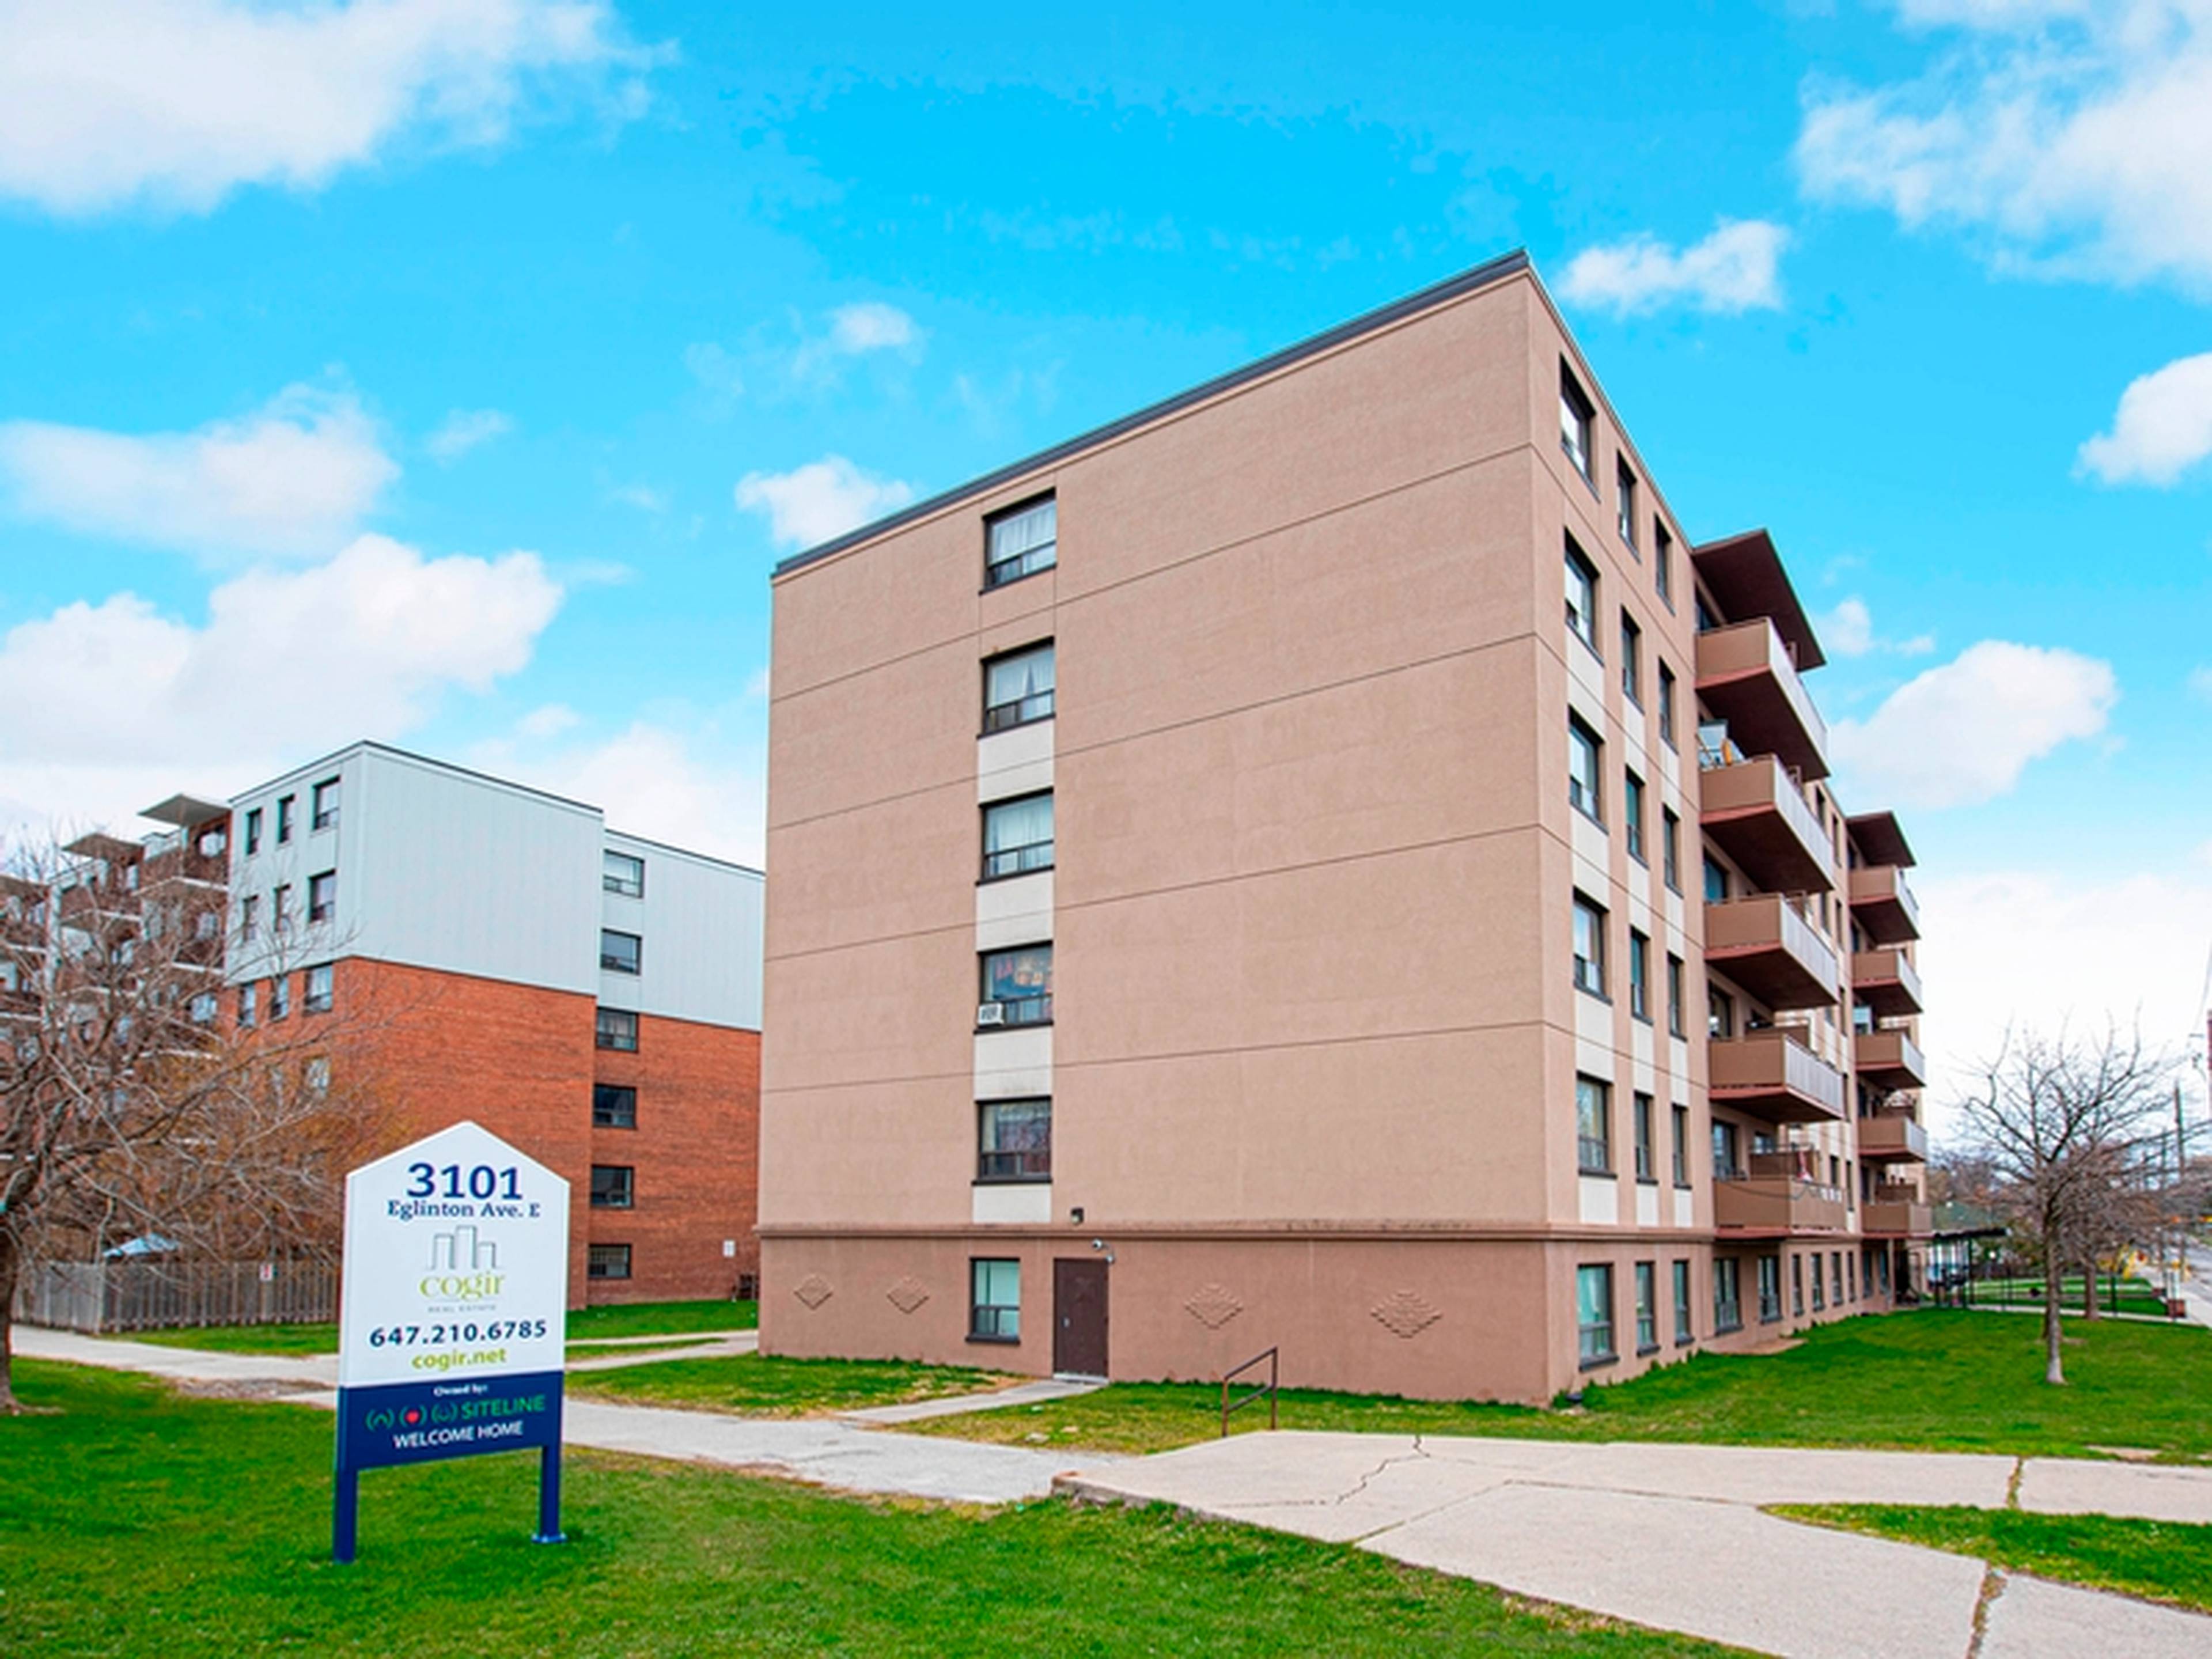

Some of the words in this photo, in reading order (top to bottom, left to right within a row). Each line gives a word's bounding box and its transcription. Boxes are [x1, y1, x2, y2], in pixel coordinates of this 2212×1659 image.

[407, 1162, 522, 1200] 3101
[388, 1200, 474, 1221] Eglinton
[481, 1202, 524, 1217] Ave.
[529, 1203, 540, 1217] E
[419, 1271, 505, 1300] cogir
[370, 1320, 547, 1347] 647.210.6785
[411, 1348, 506, 1371] cogir.net
[462, 1395, 545, 1419] SITELINE
[393, 1425, 474, 1448] WELCOME
[478, 1421, 523, 1439] HOME
